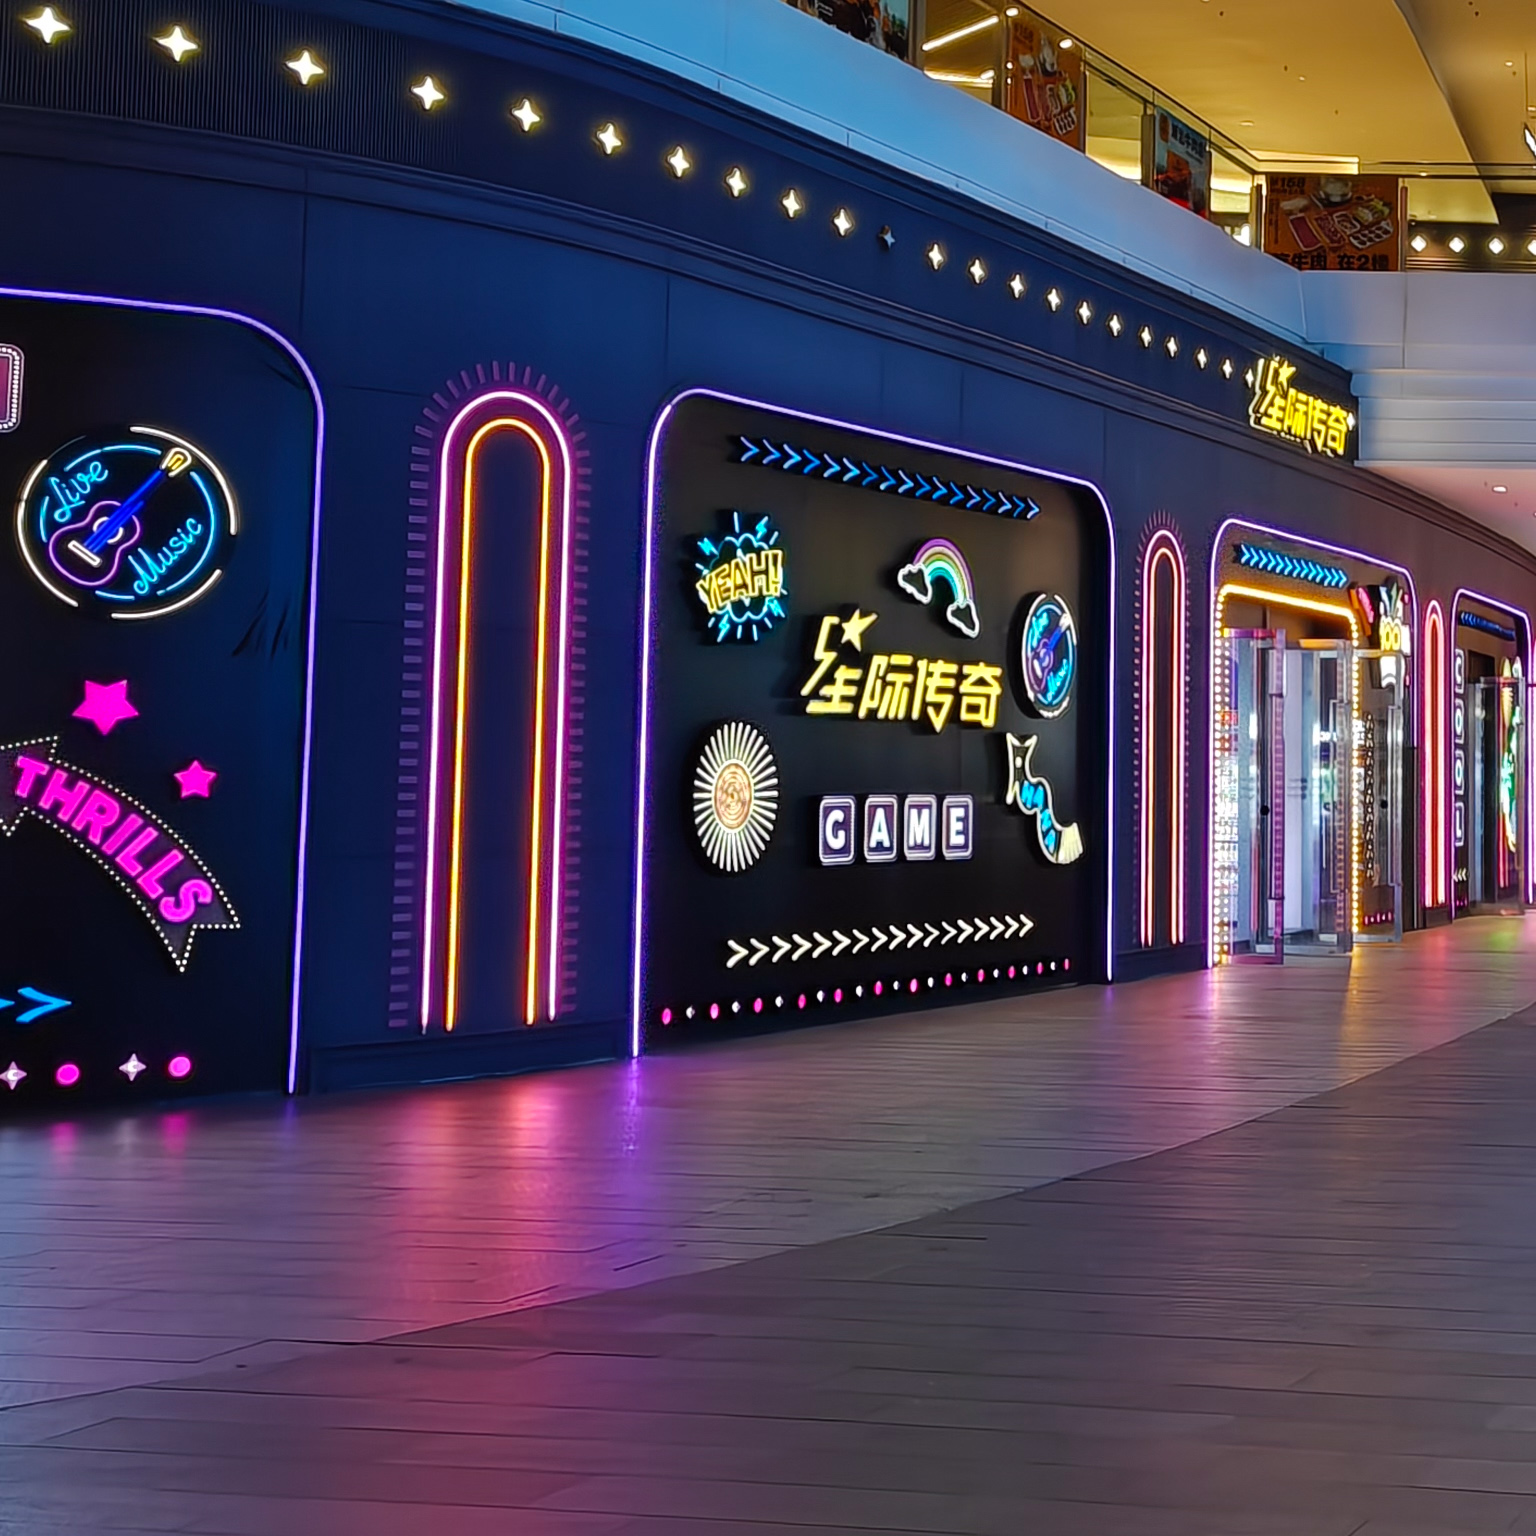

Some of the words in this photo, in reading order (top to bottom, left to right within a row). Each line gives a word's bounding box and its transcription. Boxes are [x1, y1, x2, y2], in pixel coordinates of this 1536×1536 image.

[1259, 360, 1348, 455] 星际传奇
[49, 460, 109, 523] Live
[127, 516, 202, 594] Music
[696, 549, 783, 614] YEAH!
[800, 608, 1002, 733] 星际传奇
[15, 755, 213, 923] THRILLS
[824, 807, 966, 850] GAME
